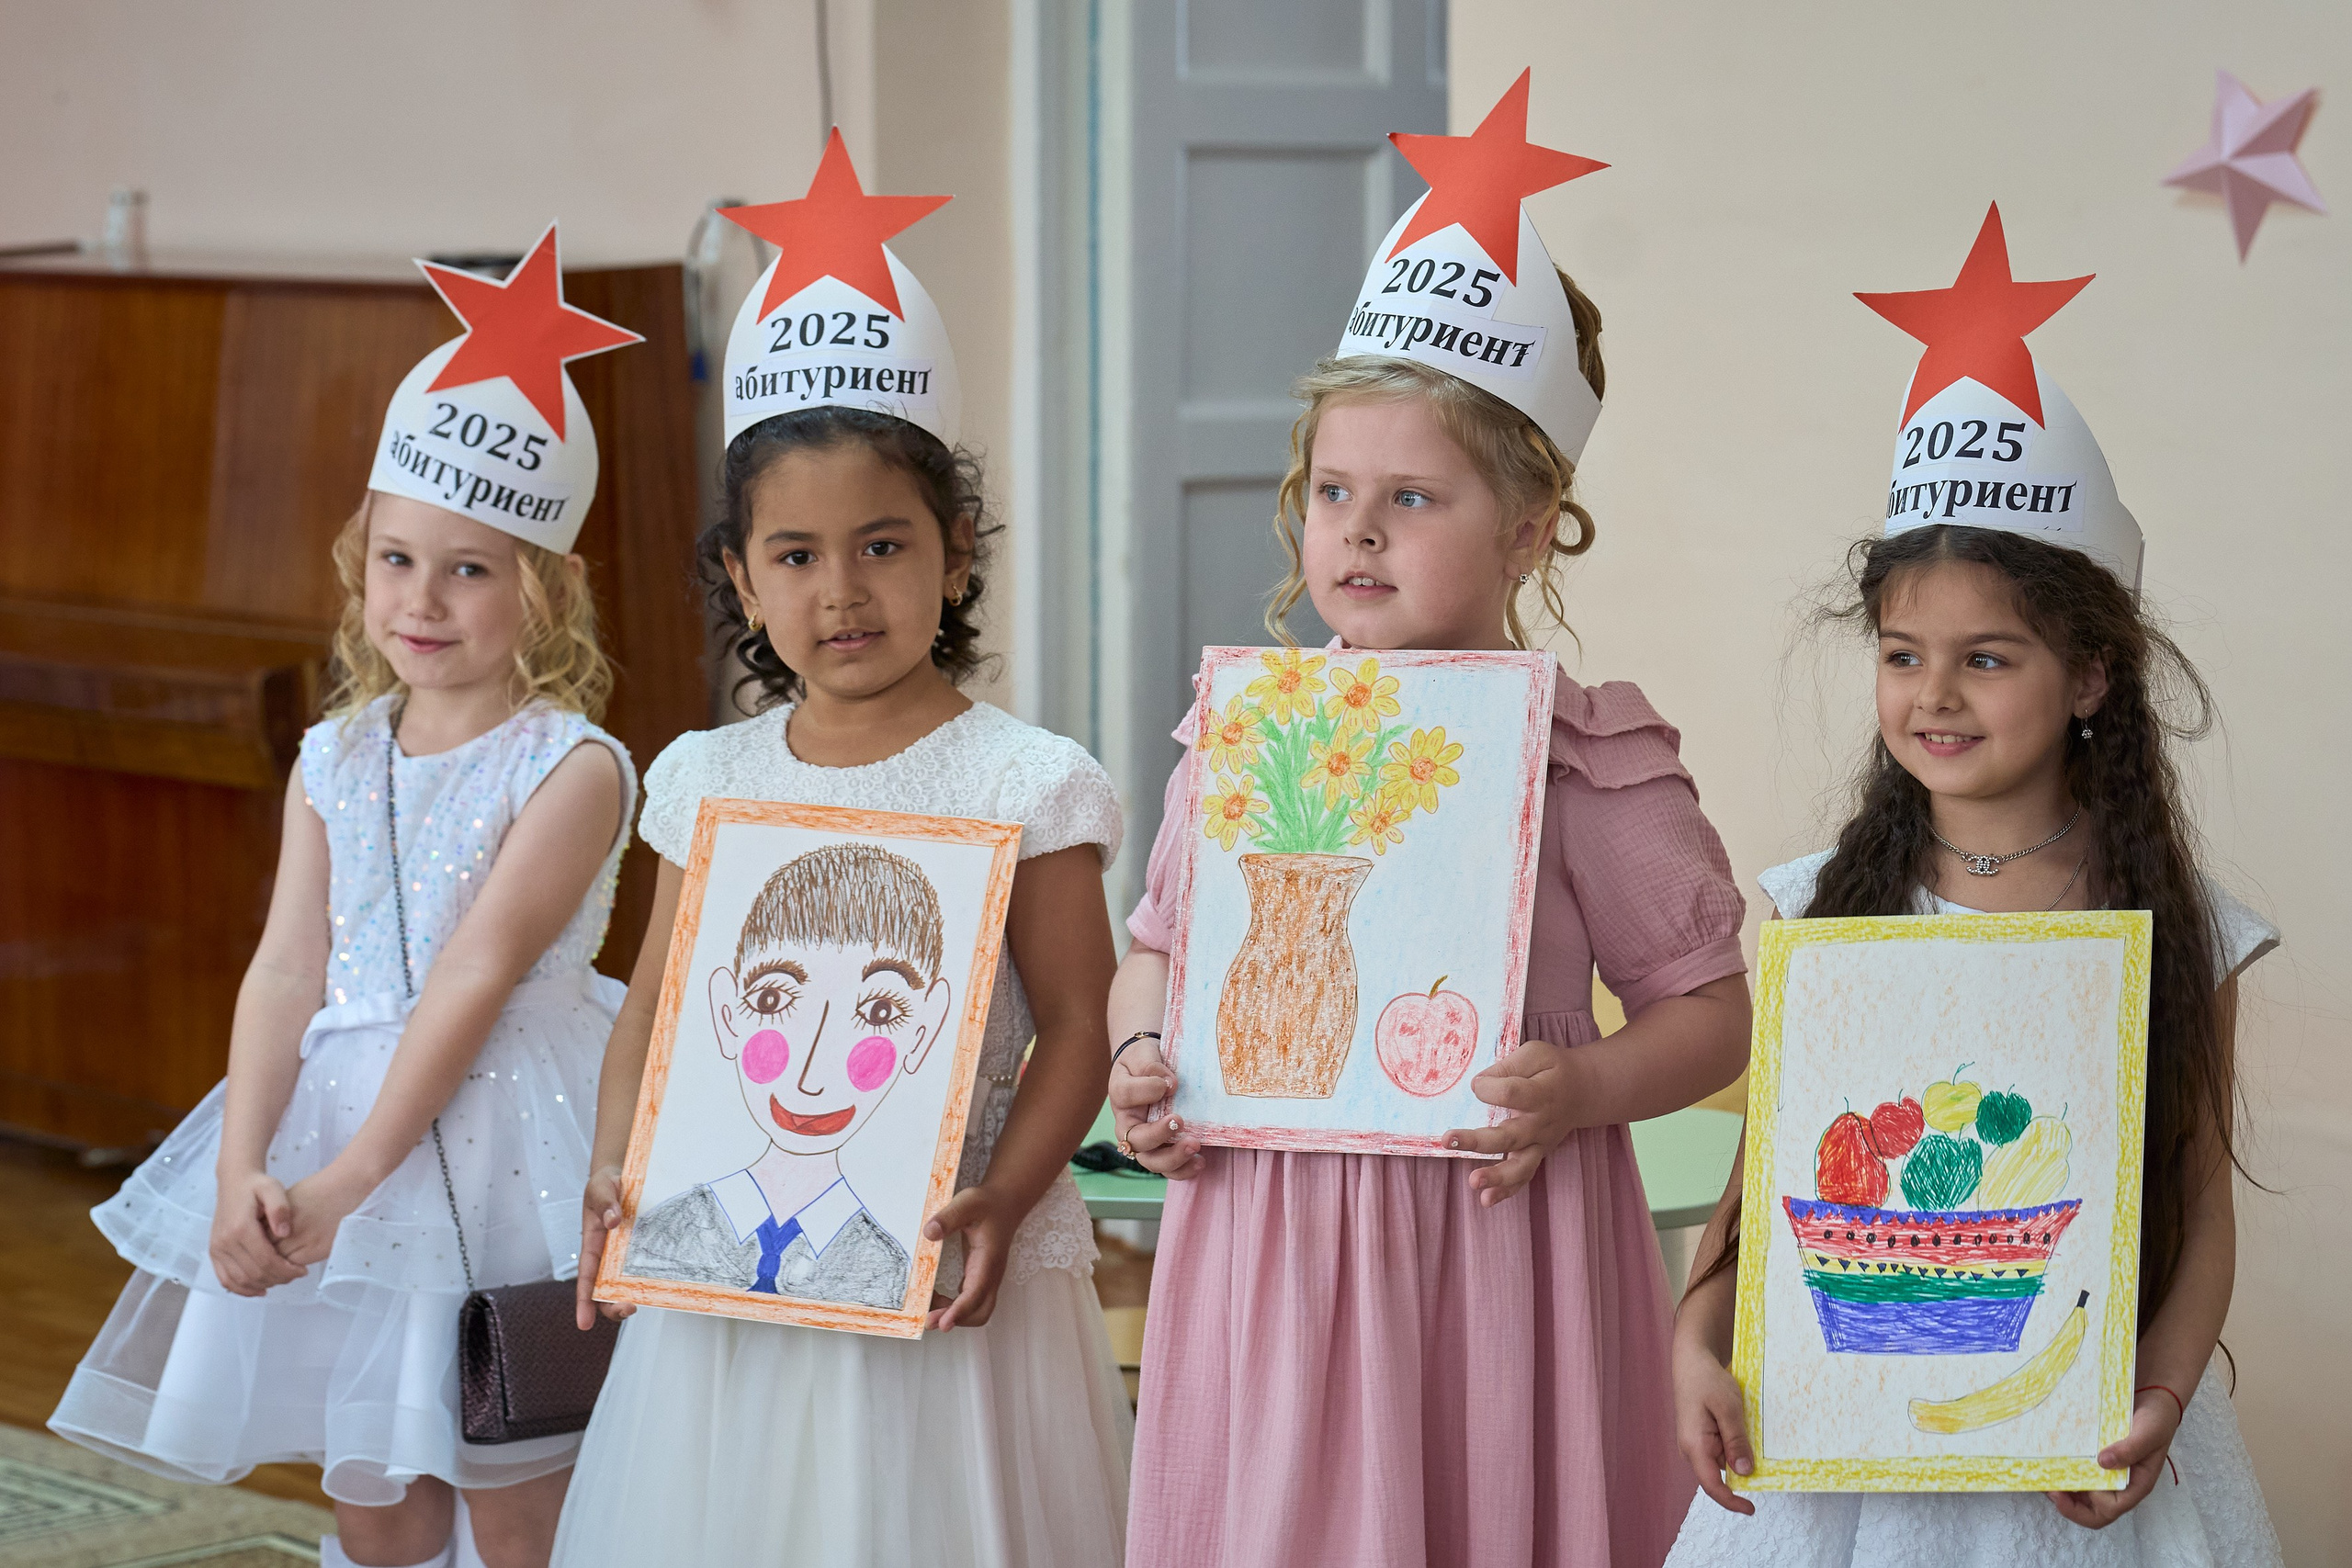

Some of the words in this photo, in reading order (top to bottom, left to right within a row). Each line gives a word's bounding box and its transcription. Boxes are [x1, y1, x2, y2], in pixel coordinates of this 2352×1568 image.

[1381, 258, 1502, 308] 2025
[768, 311, 890, 354] 2025
[735, 365, 933, 400] абитуриент
[428, 402, 548, 471] 2025
[1902, 419, 2026, 469] 2025
[1885, 479, 2078, 520] битуриент
